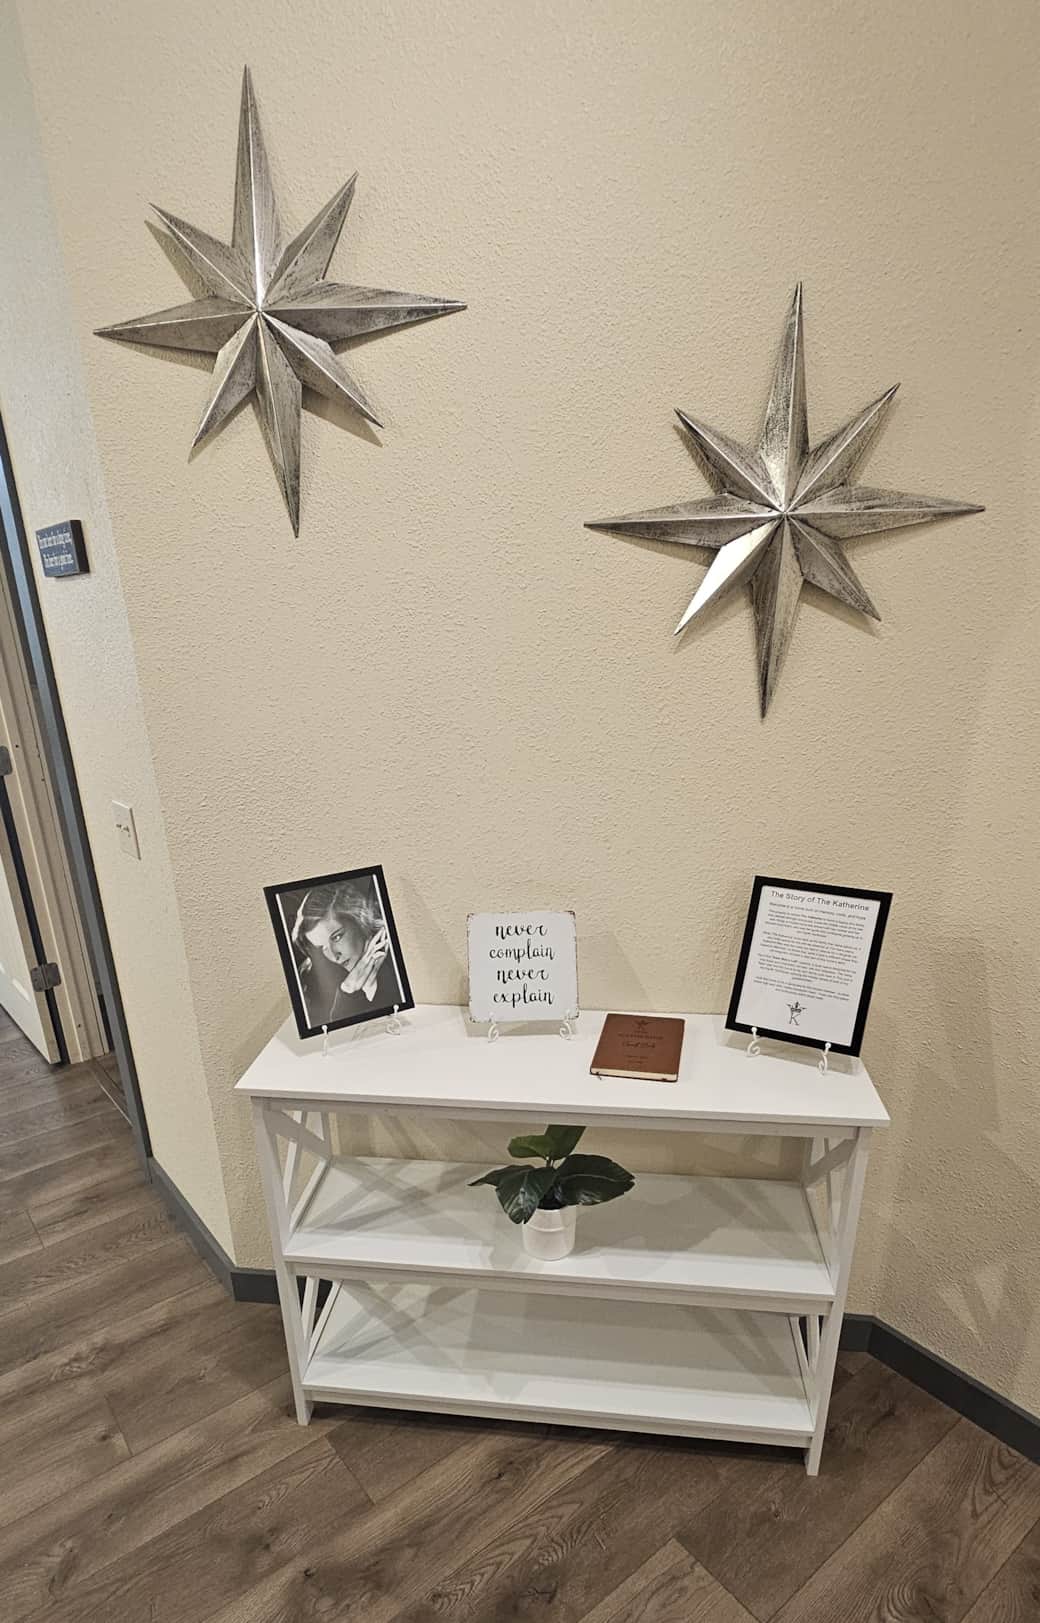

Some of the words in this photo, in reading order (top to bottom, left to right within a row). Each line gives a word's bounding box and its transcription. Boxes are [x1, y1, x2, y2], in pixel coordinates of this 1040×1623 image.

[771, 890, 784, 899] The
[785, 893, 806, 903] Story
[807, 896, 816, 904] of
[816, 897, 831, 905] The
[832, 900, 870, 911] Katherine
[495, 924, 548, 940] never
[489, 938, 556, 963] complain
[497, 967, 549, 984] never
[493, 983, 555, 1008] explain
